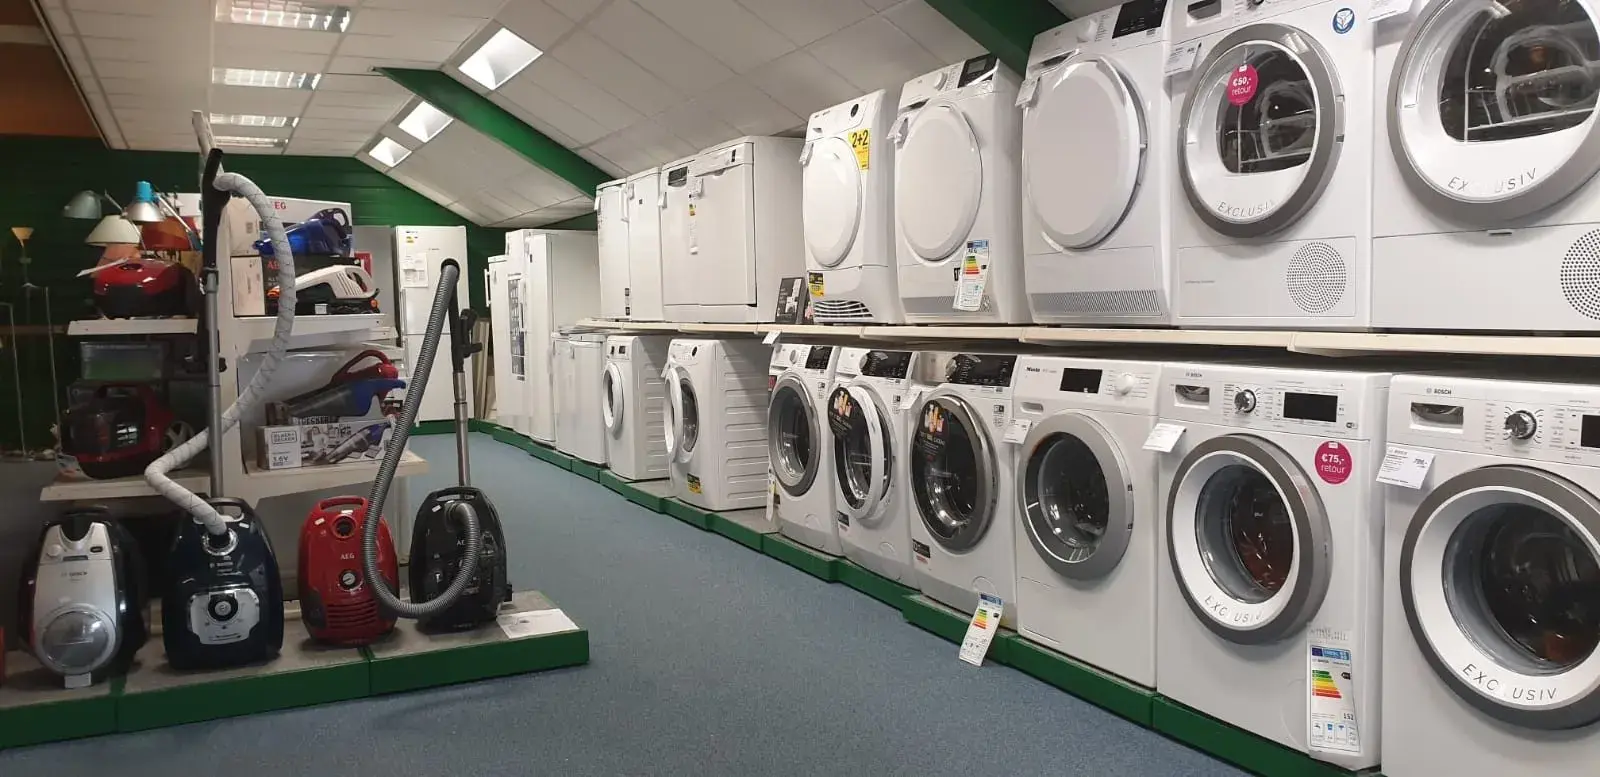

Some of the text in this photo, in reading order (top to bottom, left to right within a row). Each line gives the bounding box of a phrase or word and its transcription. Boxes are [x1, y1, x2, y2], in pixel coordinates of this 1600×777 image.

[1233, 77, 1252, 87] €50,-
[1231, 86, 1252, 96] retour
[851, 129, 869, 148] 2+2
[1448, 167, 1536, 193] EXUSIV
[274, 202, 287, 210] EG
[266, 261, 280, 270] AE
[1321, 453, 1345, 465] €75,-
[1320, 464, 1346, 474] retour
[1462, 663, 1556, 701] EXCUSIV
